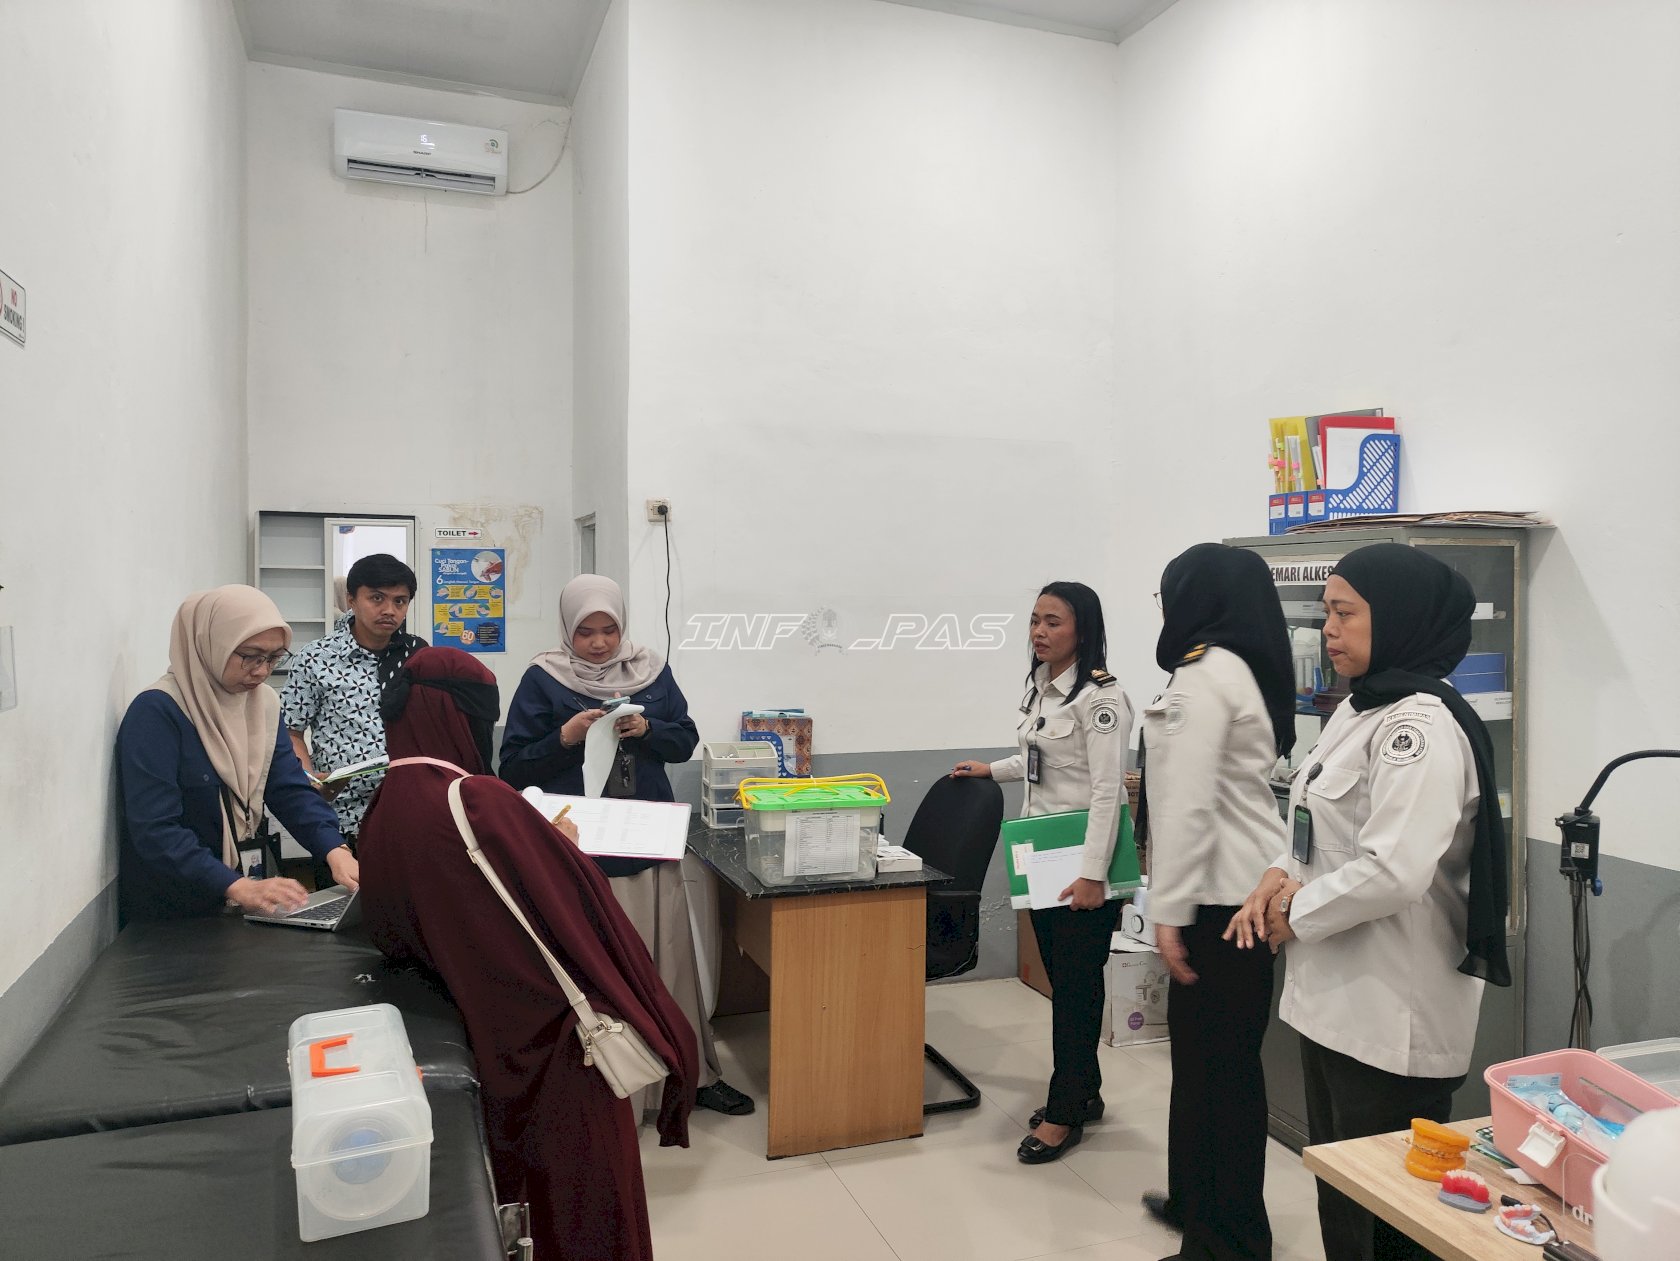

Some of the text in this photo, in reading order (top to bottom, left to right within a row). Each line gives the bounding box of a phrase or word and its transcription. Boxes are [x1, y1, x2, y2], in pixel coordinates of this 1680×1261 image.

[1270, 566, 1301, 582] EMARI
[436, 575, 443, 585] 6
[462, 631, 474, 640] 60
